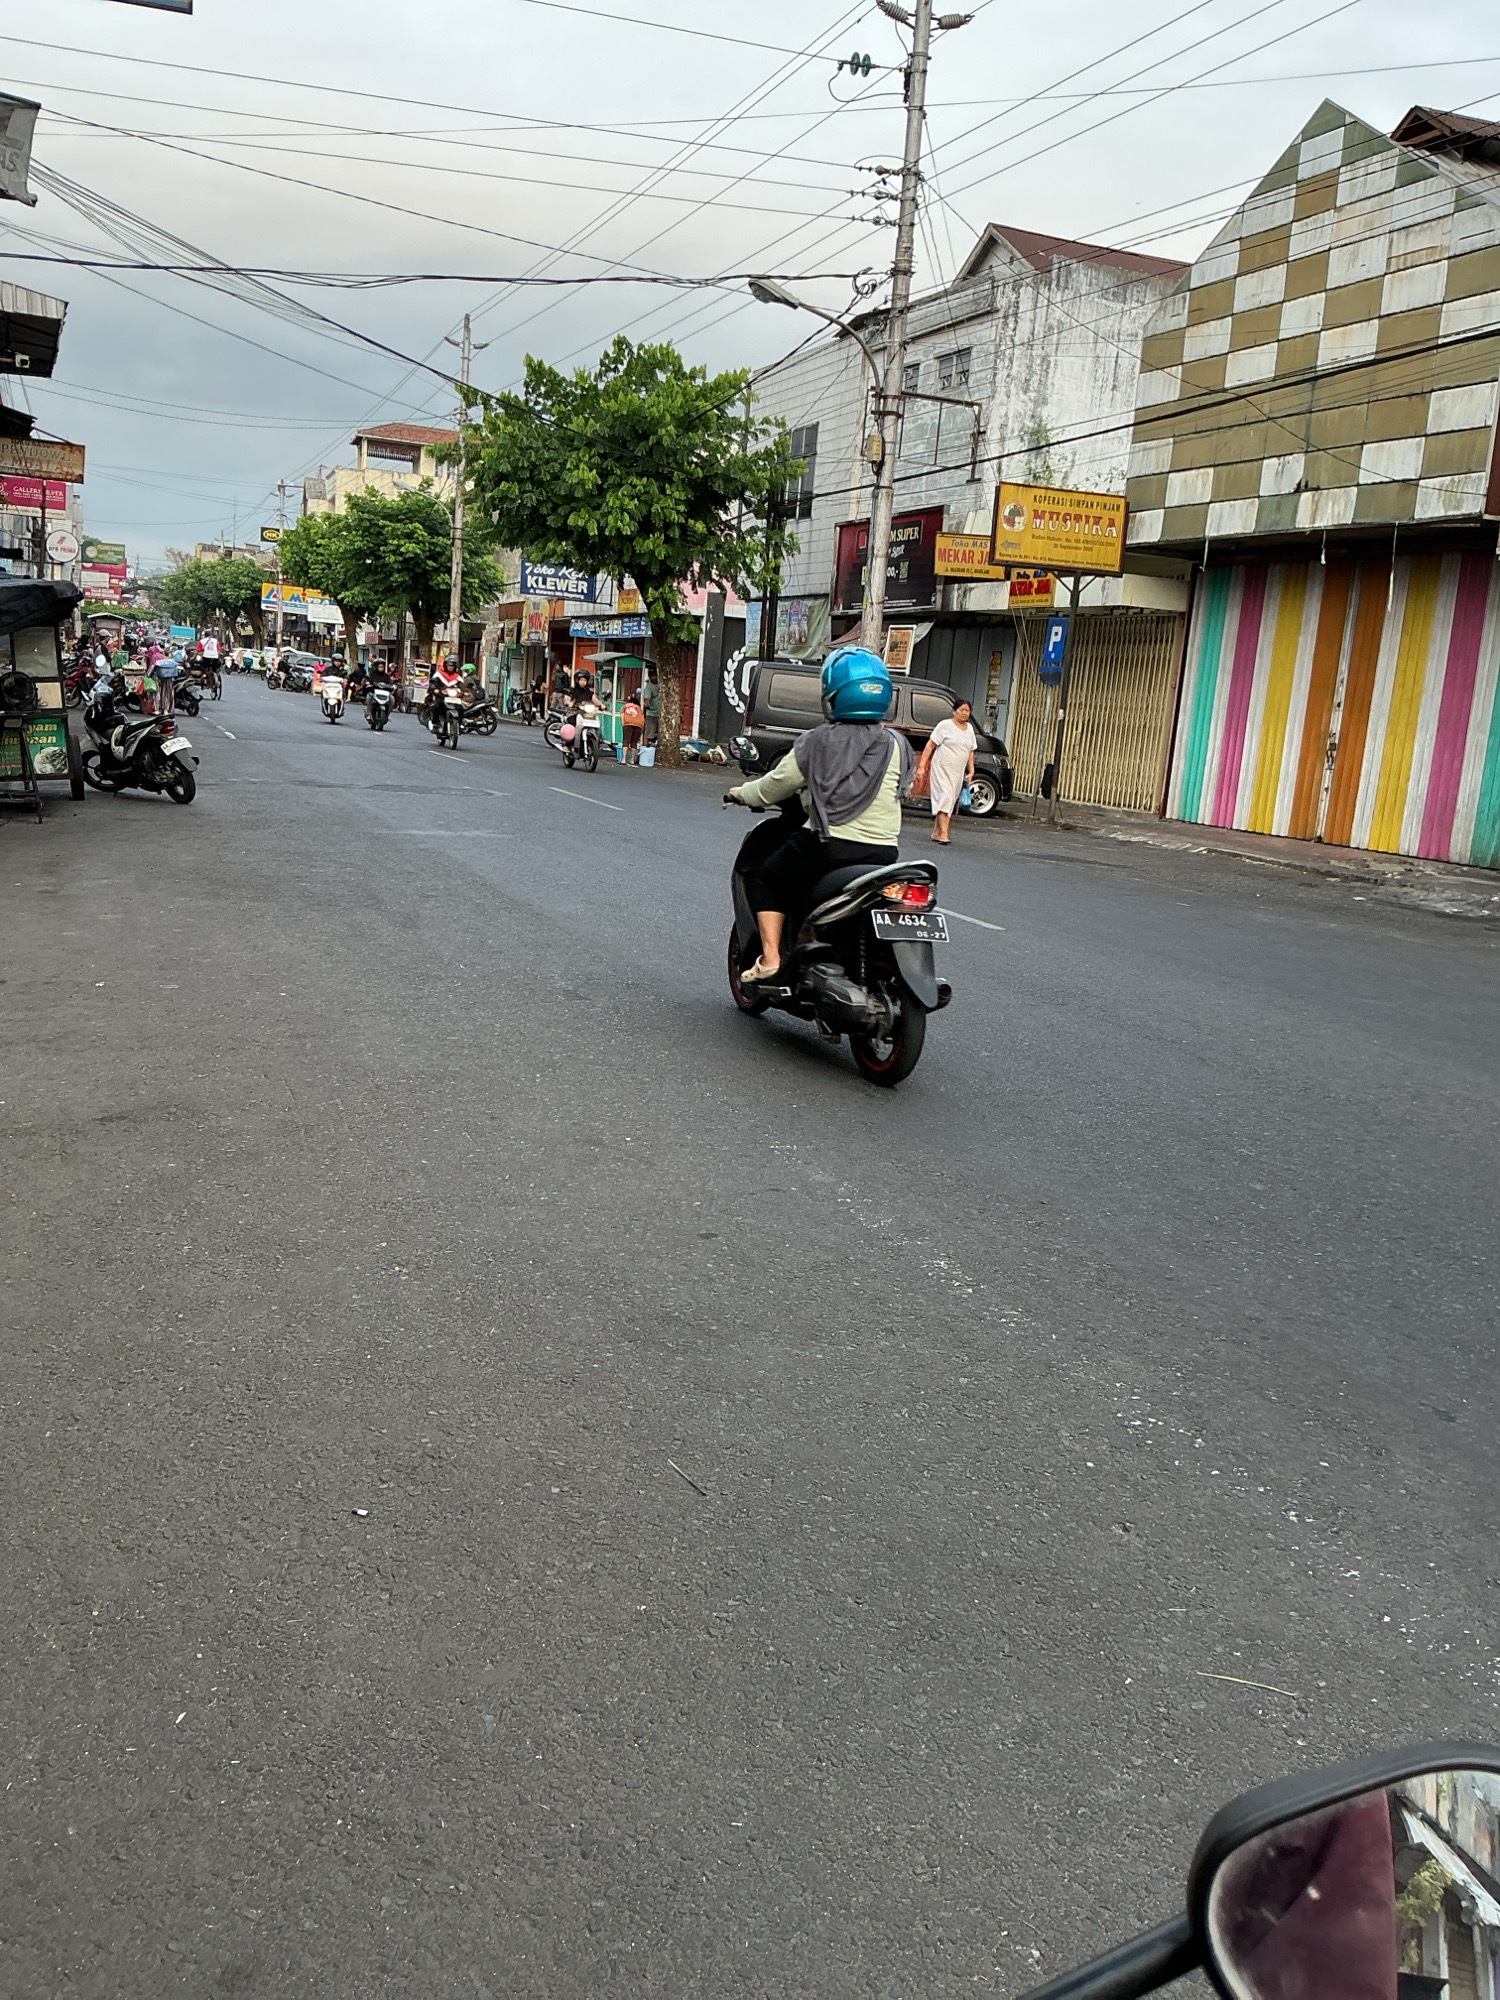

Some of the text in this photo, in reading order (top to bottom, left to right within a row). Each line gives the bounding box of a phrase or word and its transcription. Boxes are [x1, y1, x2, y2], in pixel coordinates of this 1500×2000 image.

[1, 443, 72, 462] PENDOWO
[13, 486, 41, 494] GALLERY
[1033, 494, 1121, 512] KOPERASI SIMPAN PINJAM
[1032, 509, 1118, 538] MUSTIKA
[897, 526, 919, 542] SUPER
[951, 539, 989, 549] Toko MAS
[938, 548, 975, 564] MEKAR
[525, 562, 555, 574] Toko
[527, 575, 588, 594] KLEWER
[596, 619, 622, 635] KLEWER
[1049, 626, 1063, 651] P
[27, 723, 57, 734] yam
[876, 913, 944, 928] AA 4634 T
